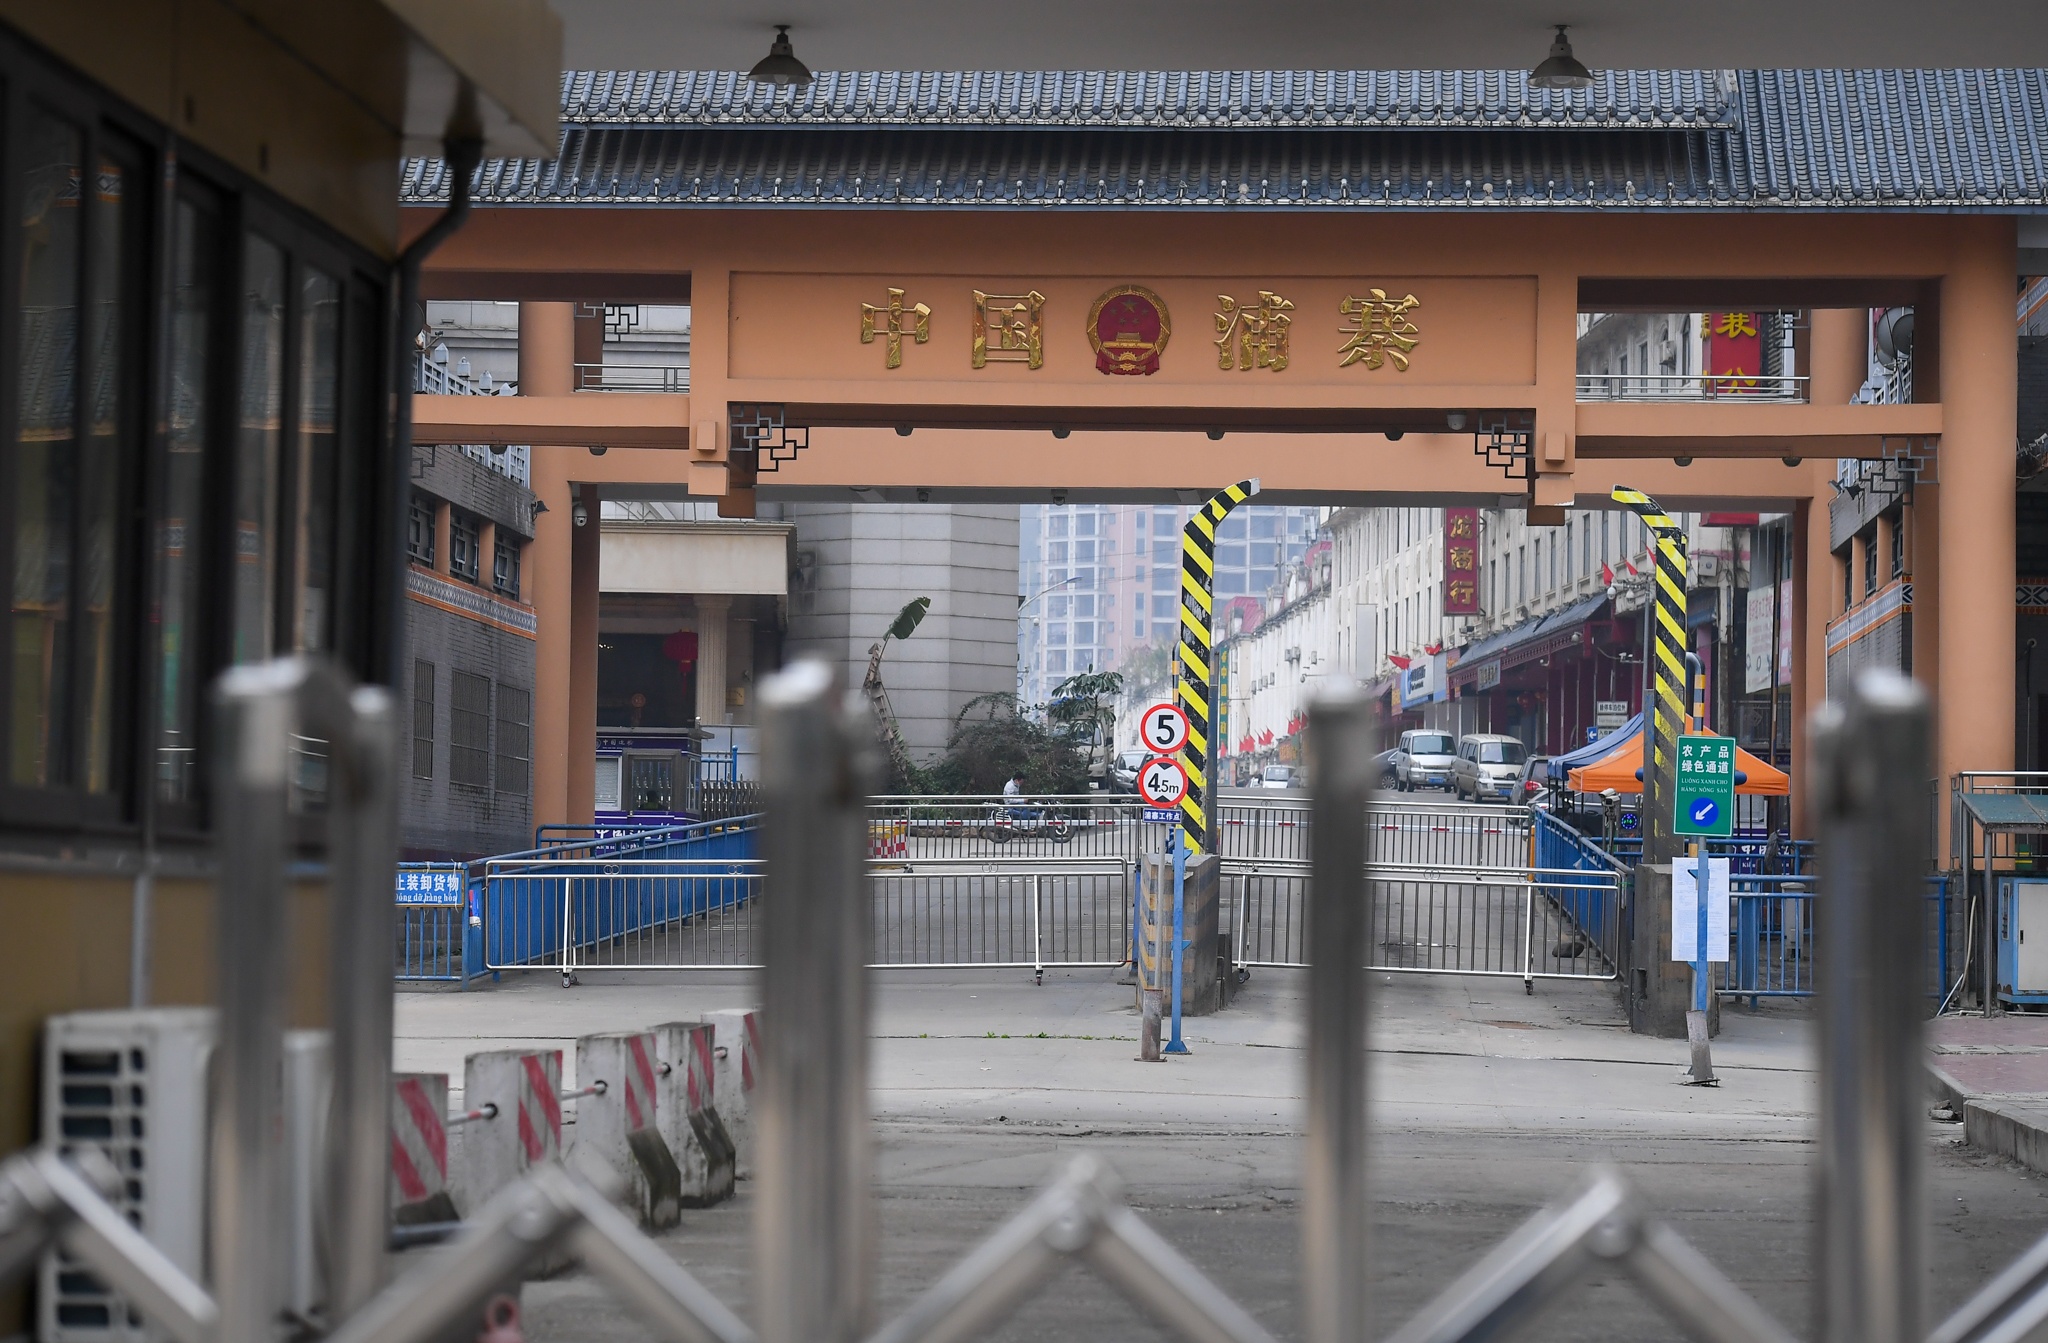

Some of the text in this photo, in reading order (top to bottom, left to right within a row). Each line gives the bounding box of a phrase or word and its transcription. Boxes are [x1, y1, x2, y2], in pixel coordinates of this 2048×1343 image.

[860, 286, 1421, 373] 中国 浦寨
[1156, 714, 1175, 745] 5
[1681, 744, 1729, 759] 农产品
[1681, 759, 1729, 774] 绿色通道
[1147, 772, 1179, 794] 4.5m
[1144, 811, 1181, 821] 浦寨工作点
